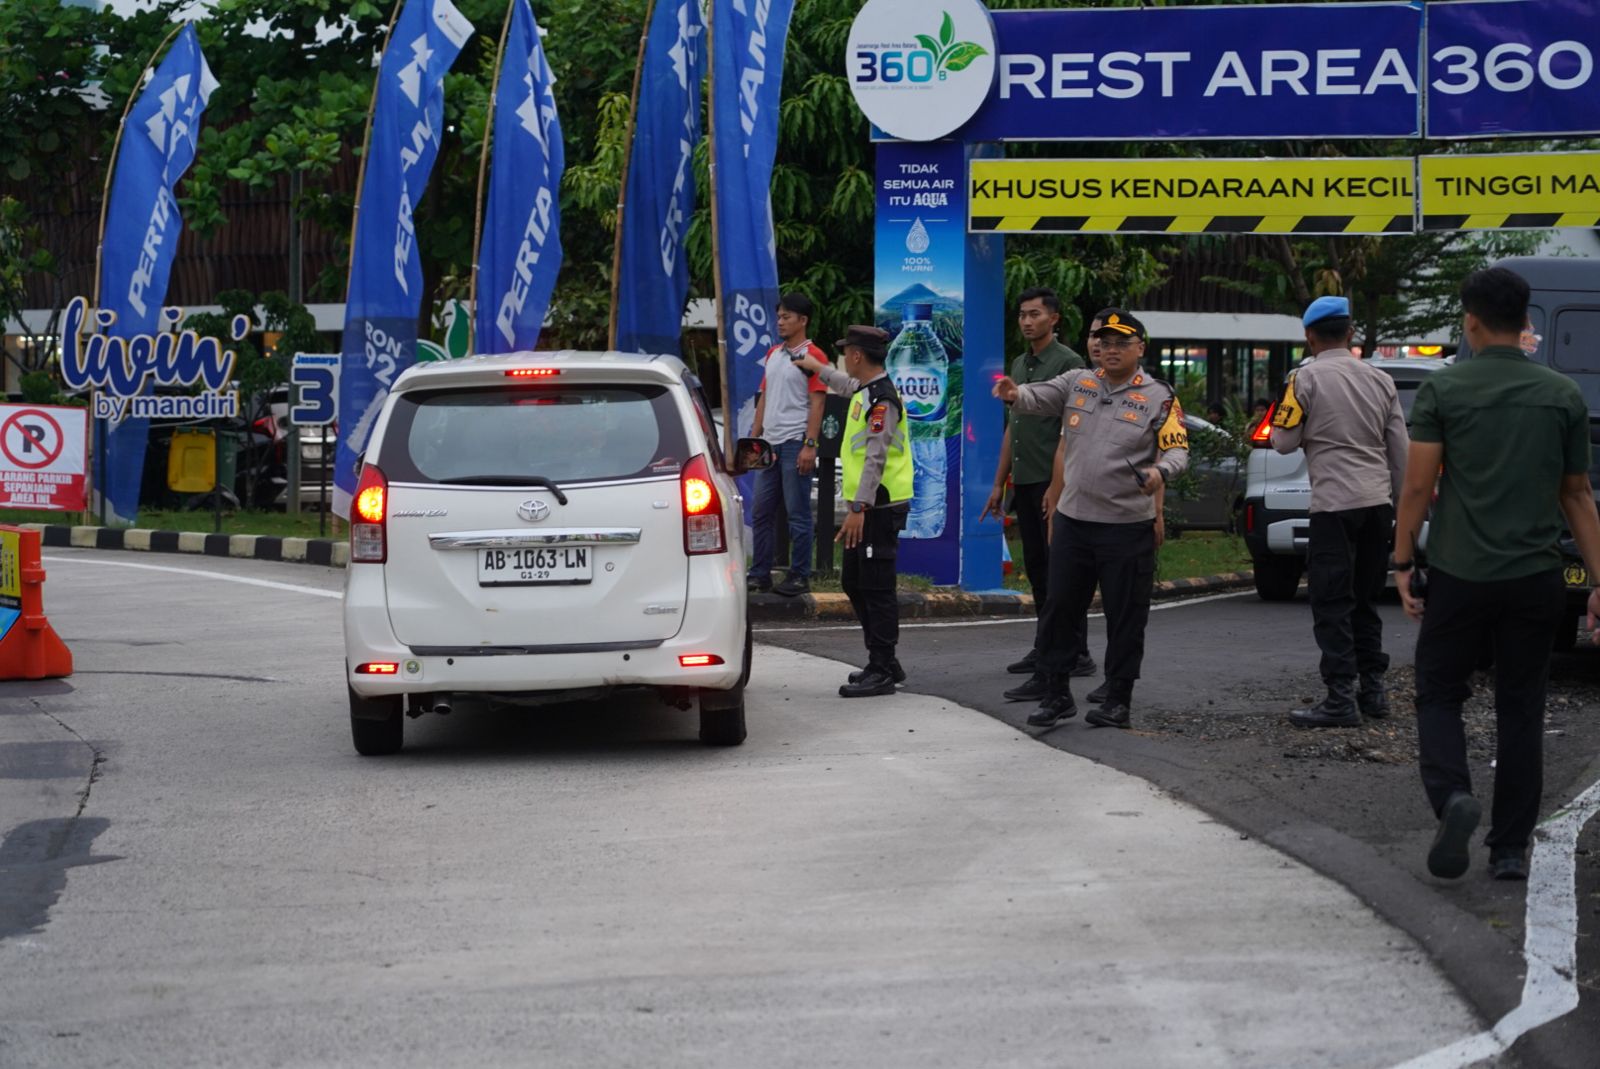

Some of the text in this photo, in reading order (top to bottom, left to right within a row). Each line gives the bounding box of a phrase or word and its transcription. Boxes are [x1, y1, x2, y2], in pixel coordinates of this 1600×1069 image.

[856, 50, 933, 82] 360
[1000, 40, 1594, 99] REST AREA 360
[899, 164, 939, 174] TIDAK
[883, 180, 955, 189] SEMUA AIR
[972, 177, 1414, 199] KHUSUS KENDARAAN KECIL
[1435, 175, 1541, 196] TINGGI
[889, 193, 948, 208] ITU AQUA
[904, 257, 931, 265] 100%
[365, 320, 402, 359] RON
[365, 341, 396, 386] 92
[896, 376, 940, 400] AQUA
[95, 390, 238, 423] by mandiri
[1121, 400, 1149, 413] POLRI
[485, 548, 586, 570] AB 1063 LN
